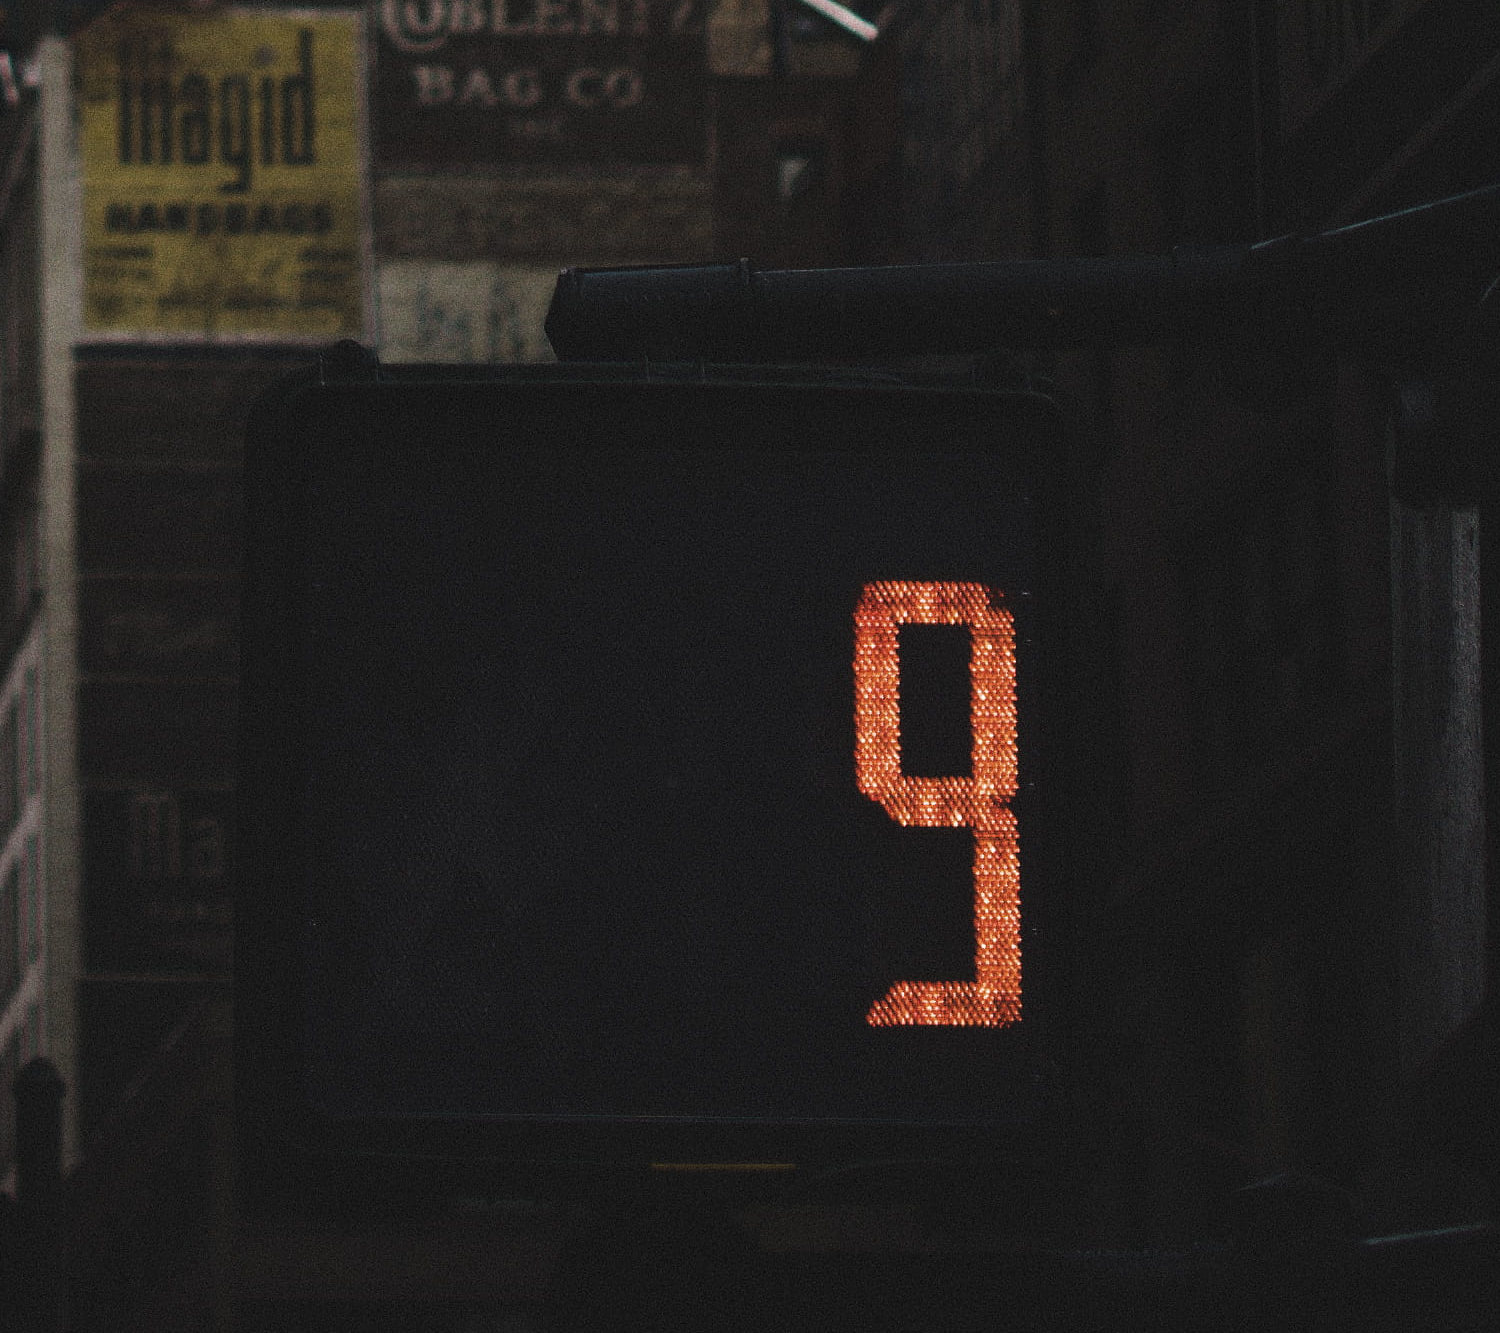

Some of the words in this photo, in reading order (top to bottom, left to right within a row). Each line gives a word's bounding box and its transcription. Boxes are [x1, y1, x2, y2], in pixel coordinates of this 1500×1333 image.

[410, 64, 545, 108] BAG
[104, 201, 335, 235] HANDBAGS
[853, 580, 1022, 1026] 9
